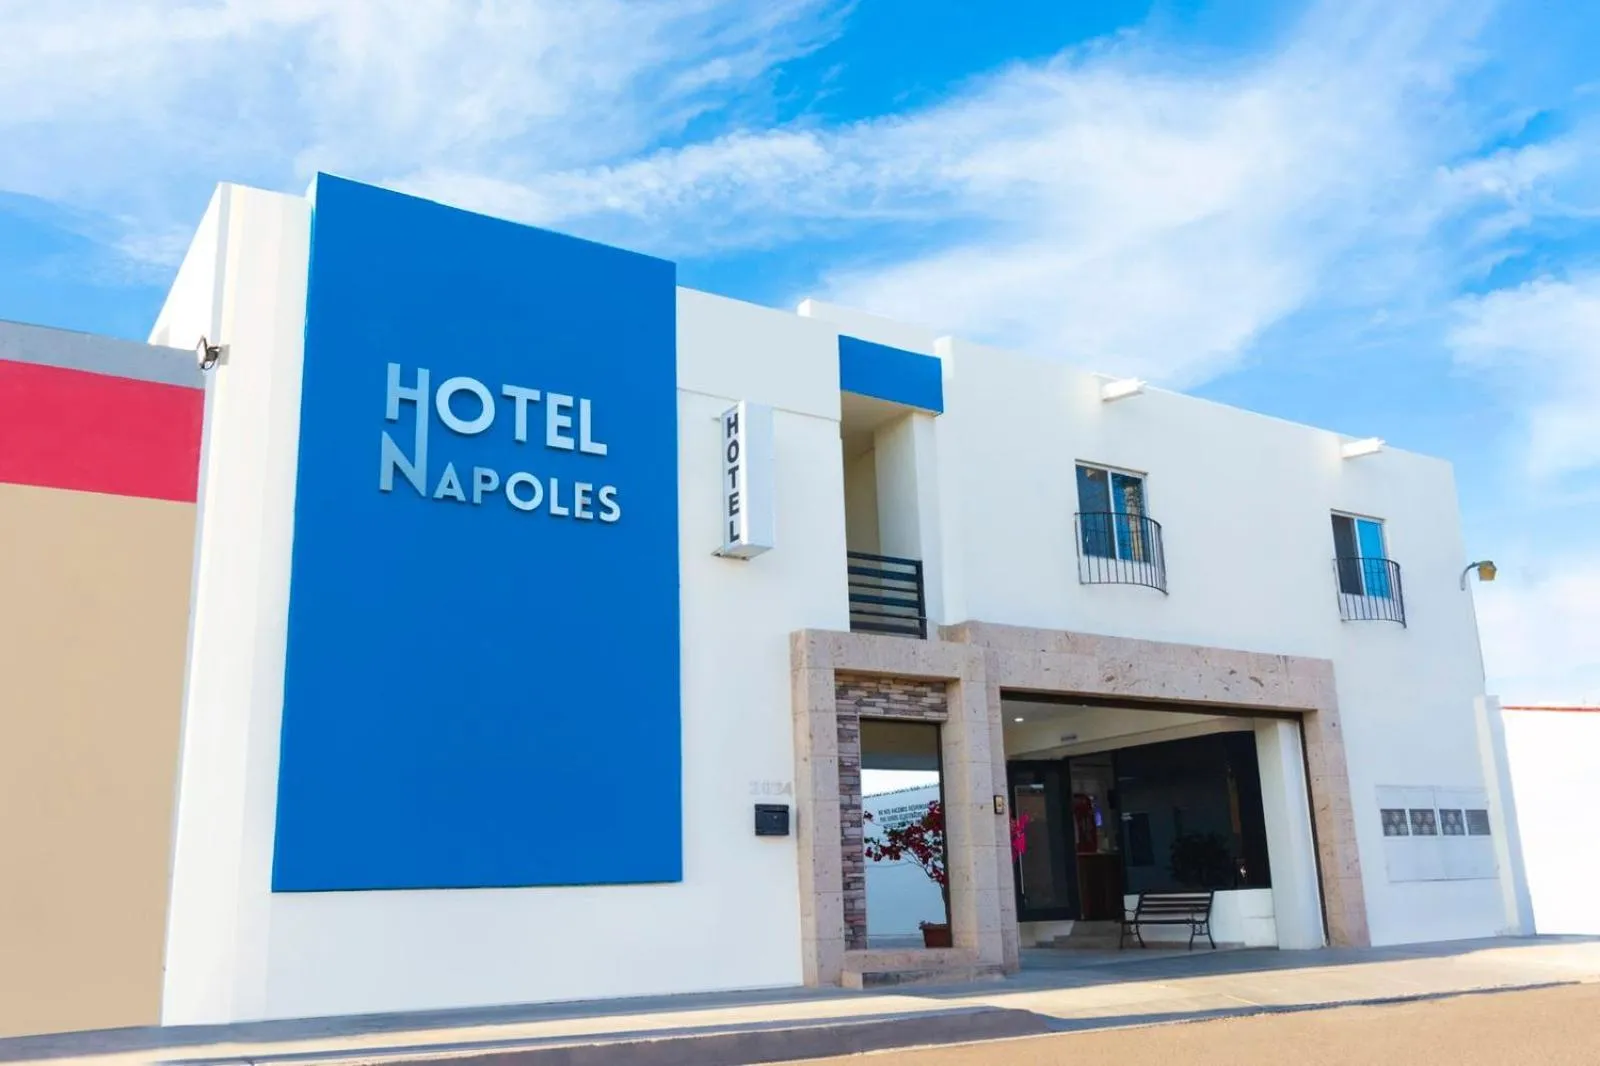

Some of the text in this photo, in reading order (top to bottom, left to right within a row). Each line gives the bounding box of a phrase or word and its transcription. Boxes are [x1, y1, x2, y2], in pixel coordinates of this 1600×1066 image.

[385, 362, 608, 456] HOTEL
[379, 430, 622, 523] NAPOLES
[726, 412, 740, 544] HOTEL
